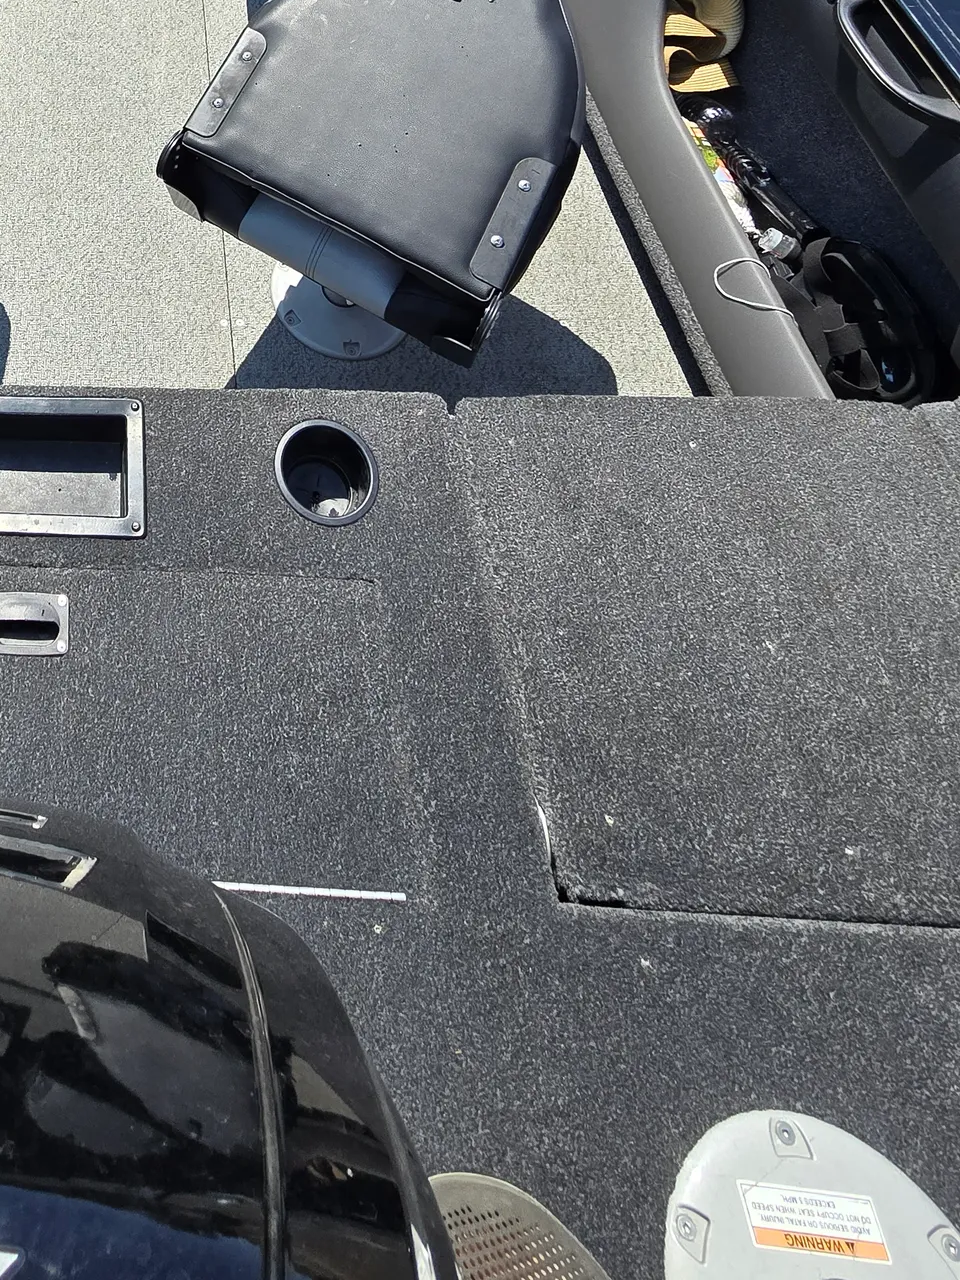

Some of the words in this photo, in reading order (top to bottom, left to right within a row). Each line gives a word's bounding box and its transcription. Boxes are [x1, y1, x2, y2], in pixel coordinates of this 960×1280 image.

[752, 1201, 775, 1212] SPEED
[803, 1197, 836, 1208] EXCEEDS
[776, 1204, 797, 1214] WHEN
[798, 1208, 815, 1217] SEAT
[817, 1210, 844, 1220] OCCUPY
[846, 1214, 860, 1222] NOT
[860, 1215, 872, 1224] DO
[785, 1217, 806, 1227] FATAL
[807, 1220, 818, 1228] OR
[819, 1221, 849, 1232] SERIOUS
[851, 1225, 871, 1235] AVOID
[784, 1233, 846, 1253] WARNING
